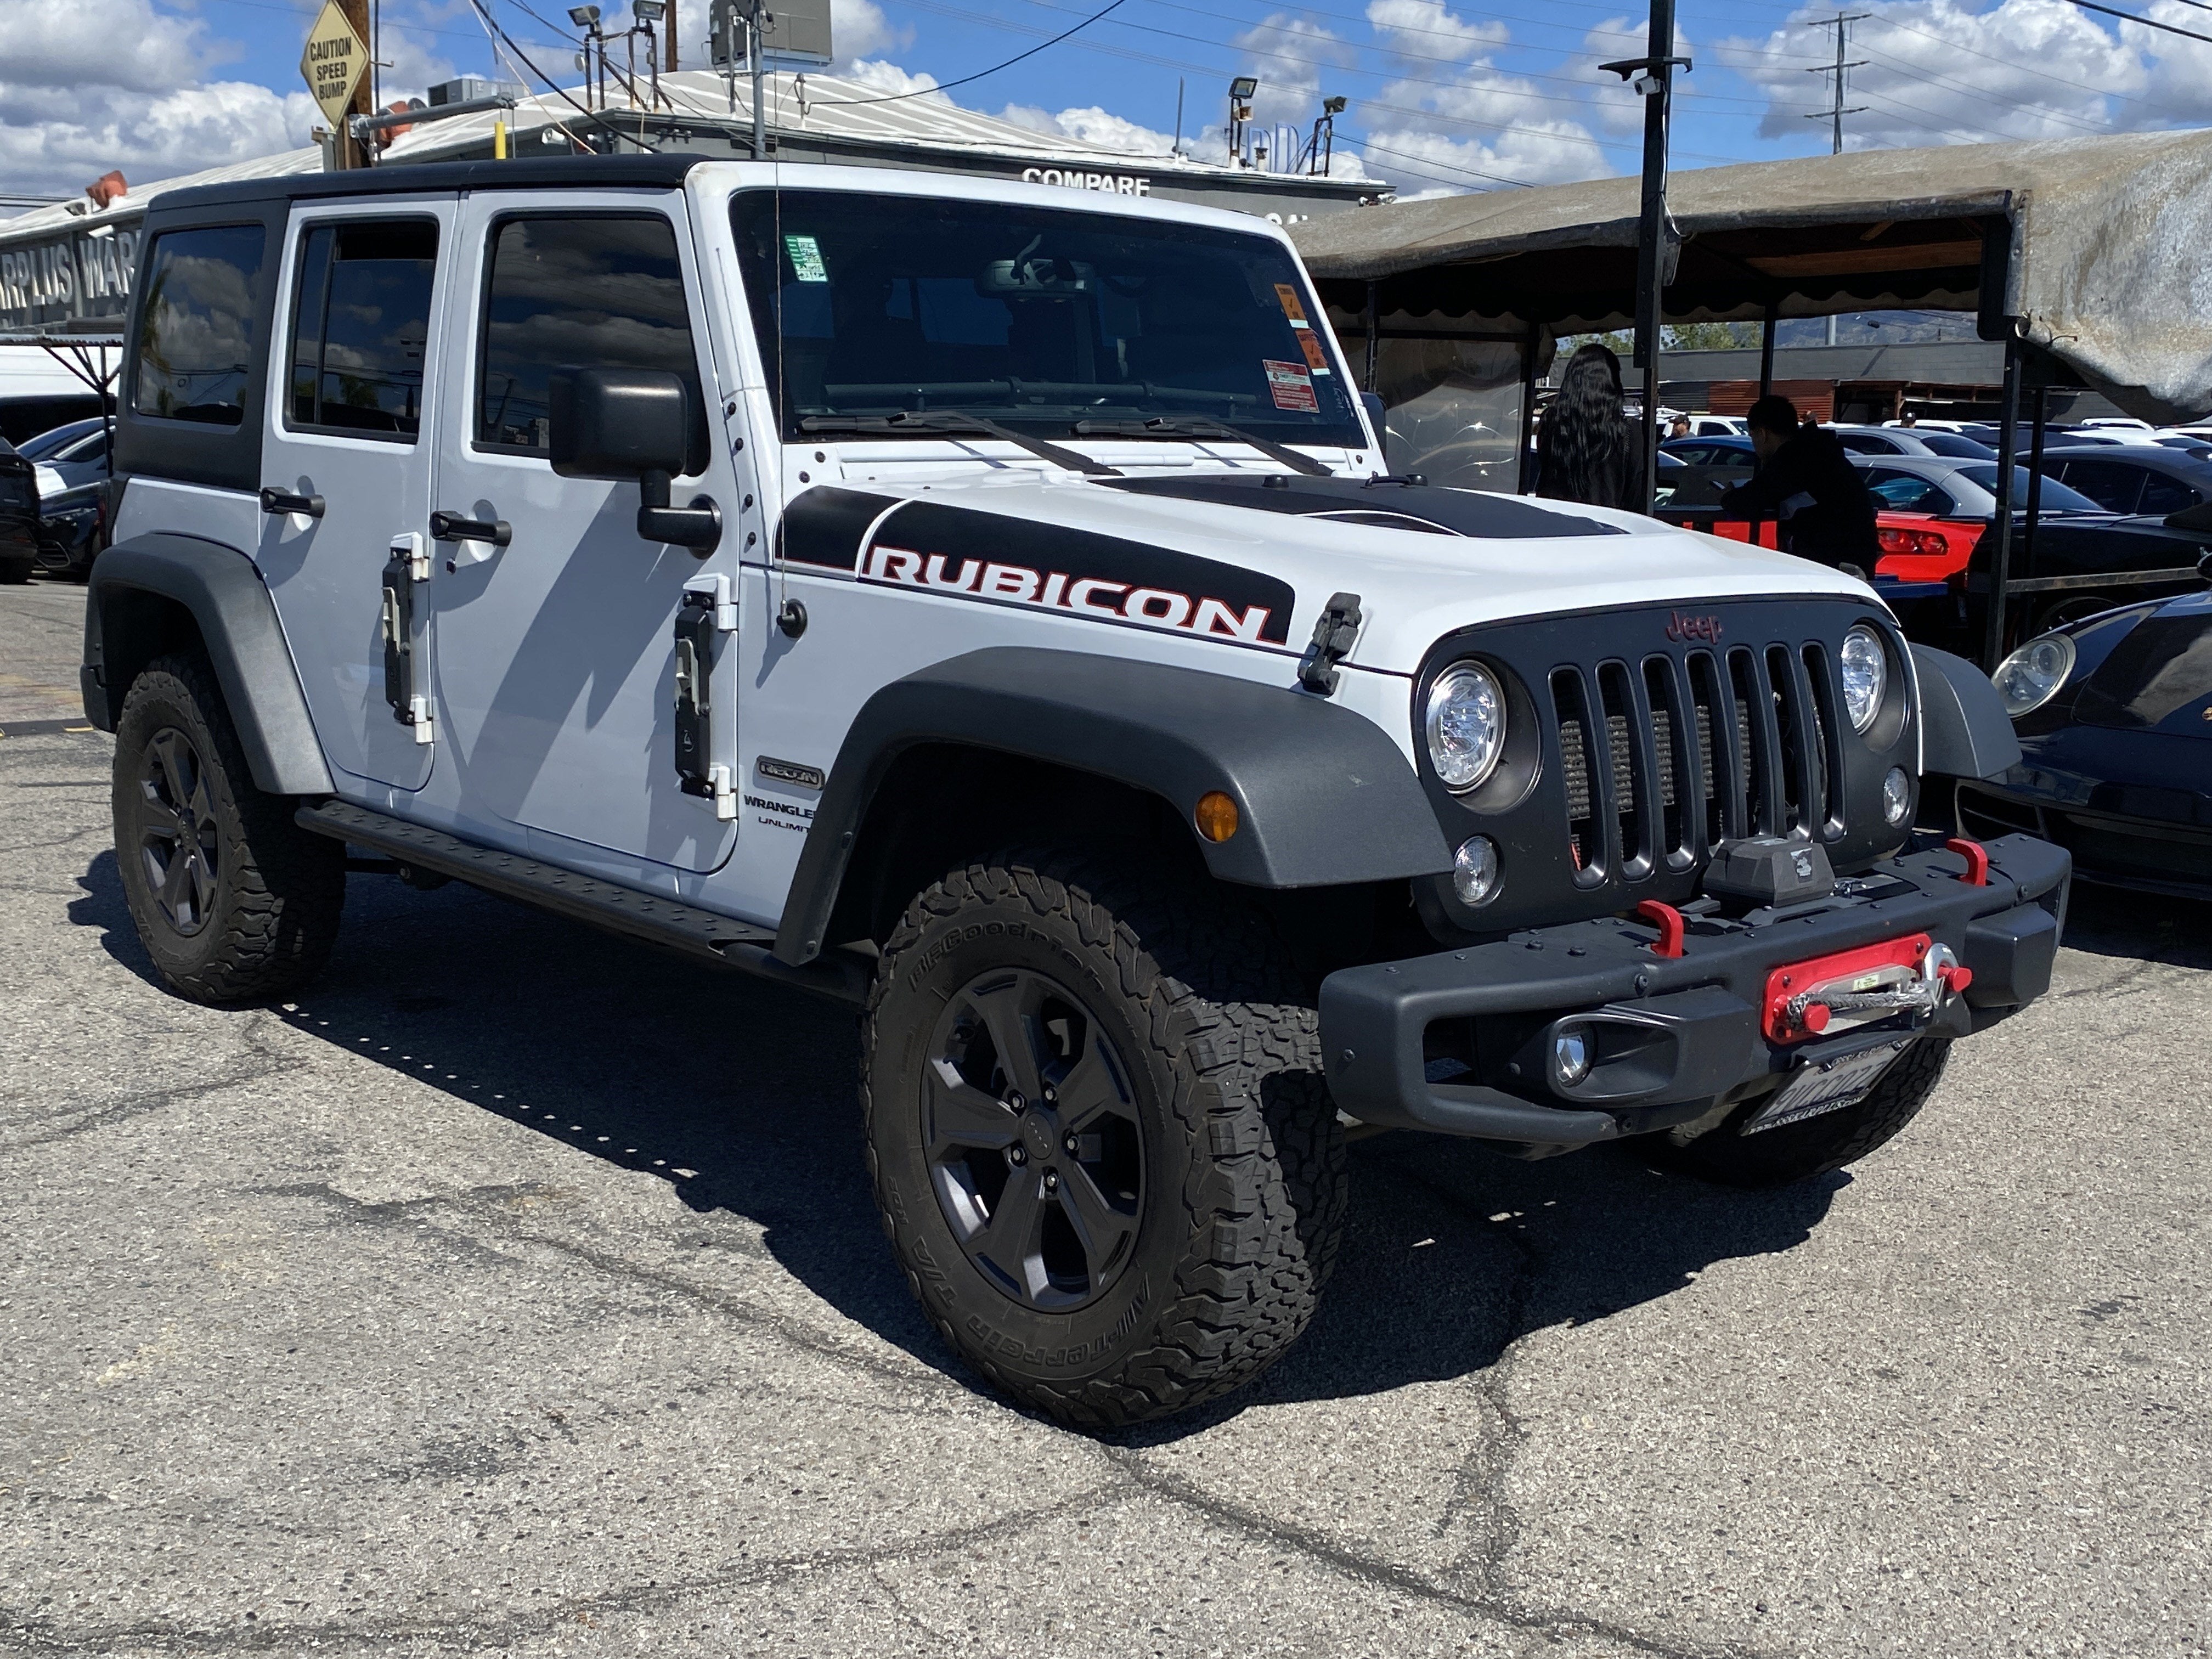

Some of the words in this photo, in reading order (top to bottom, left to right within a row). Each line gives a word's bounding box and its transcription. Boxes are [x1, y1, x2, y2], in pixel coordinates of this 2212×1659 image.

[310, 36, 352, 61] CAUTION
[317, 61, 347, 81] SPEED
[319, 81, 346, 100] BUMP
[78, 229, 143, 298] WAR
[861, 545, 1286, 646] RUBICON
[1666, 611, 1722, 645] Jeep
[760, 763, 818, 783] RECON
[744, 794, 816, 819] WRANGLE
[908, 920, 1105, 992] BFGoodrich
